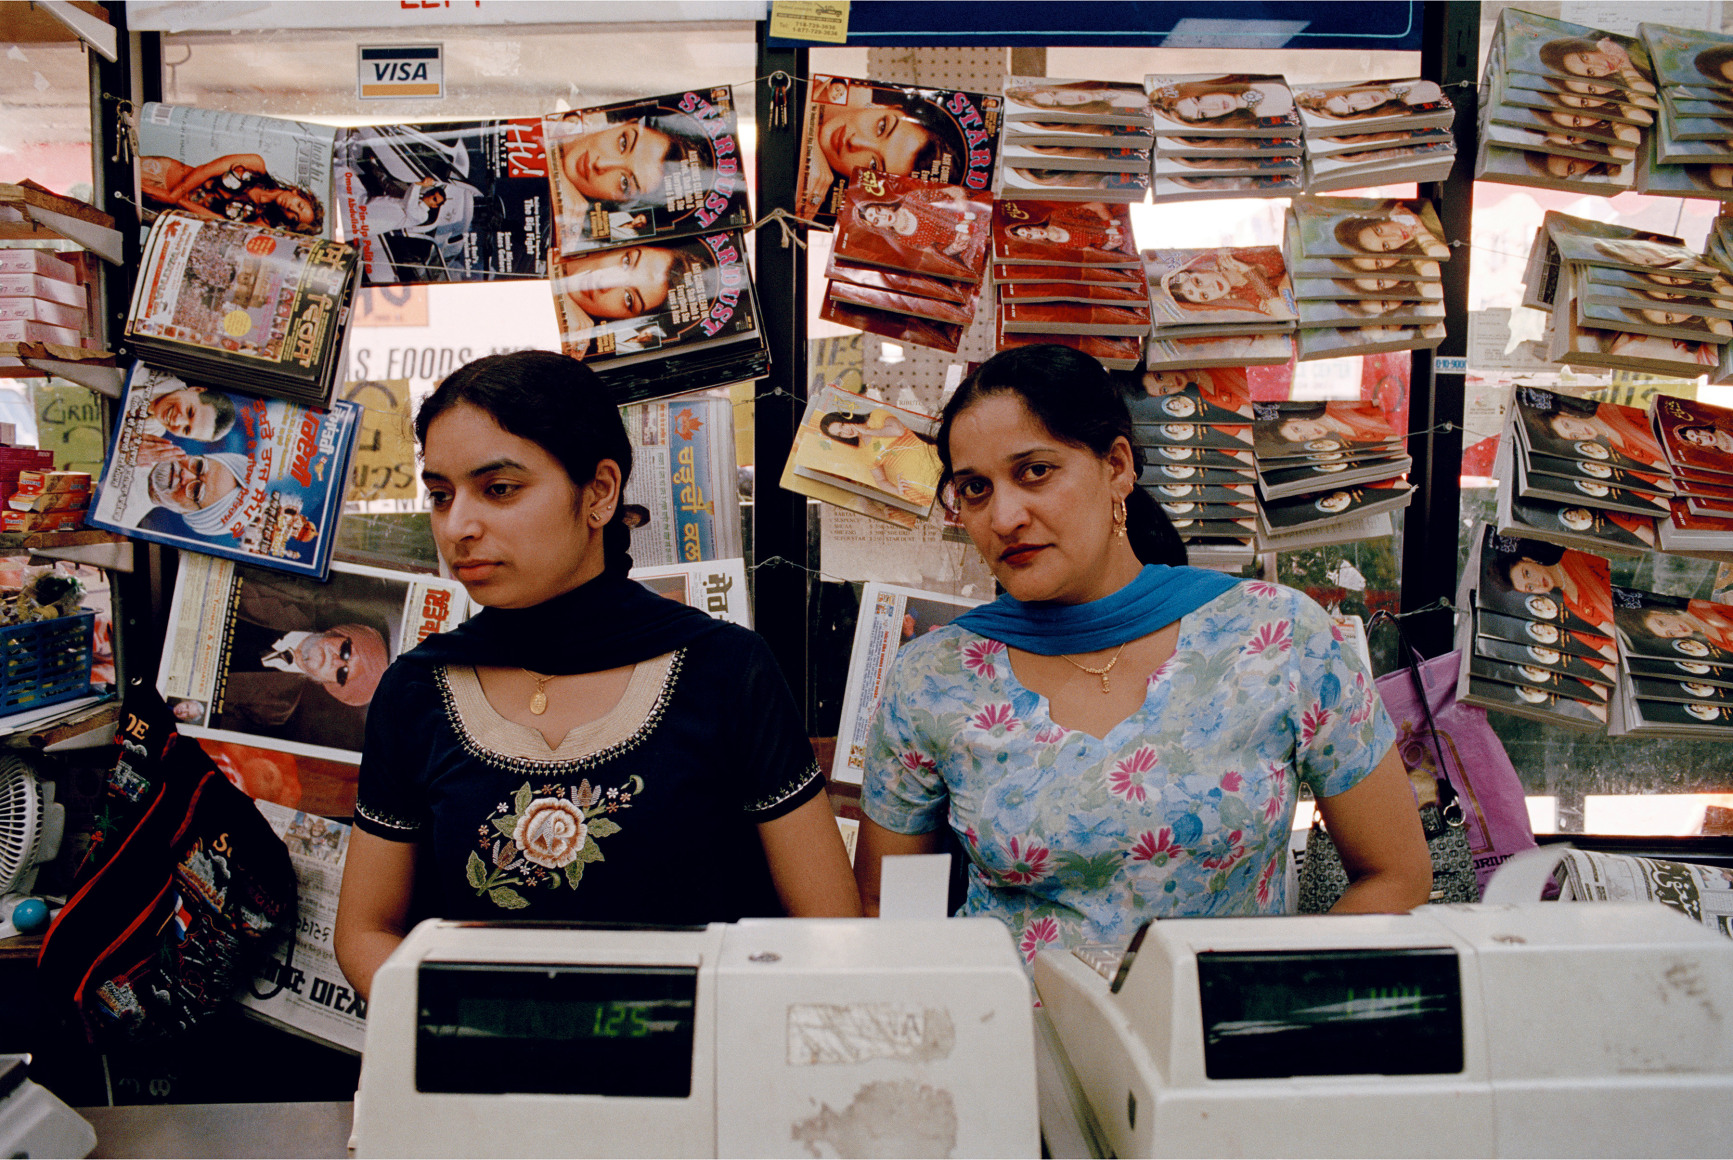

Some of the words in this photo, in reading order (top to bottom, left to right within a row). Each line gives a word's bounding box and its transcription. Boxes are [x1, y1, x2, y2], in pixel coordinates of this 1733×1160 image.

[372, 61, 429, 83] VISA
[504, 124, 546, 176] Hi!
[945, 91, 990, 188] STARD
[678, 91, 738, 229] STARDUST
[940, 152, 952, 165] ASH
[690, 162, 702, 181] COMES
[344, 172, 354, 194] Omar
[693, 182, 704, 200] CLEAN
[348, 198, 359, 234] Abdullah
[524, 199, 533, 215] The
[358, 205, 370, 237] Pin-Up
[524, 216, 533, 232] Big
[497, 231, 505, 246] Aces
[504, 231, 512, 251] Sania
[525, 233, 535, 255] Fight
[362, 239, 373, 274] Politco
[691, 263, 702, 274] ASH
[694, 275, 705, 293] COMES
[699, 234, 742, 337] ARDUST
[667, 289, 677, 305] Loves
[676, 284, 688, 311] Everything
[696, 294, 708, 310] CLEAN
[680, 311, 690, 323] She
[293, 293, 333, 367] ਵਿਰਸਾ
[388, 348, 472, 380] FOODS
[255, 445, 275, 483] ਤਾਜ
[683, 522, 701, 563] ਕਲ
